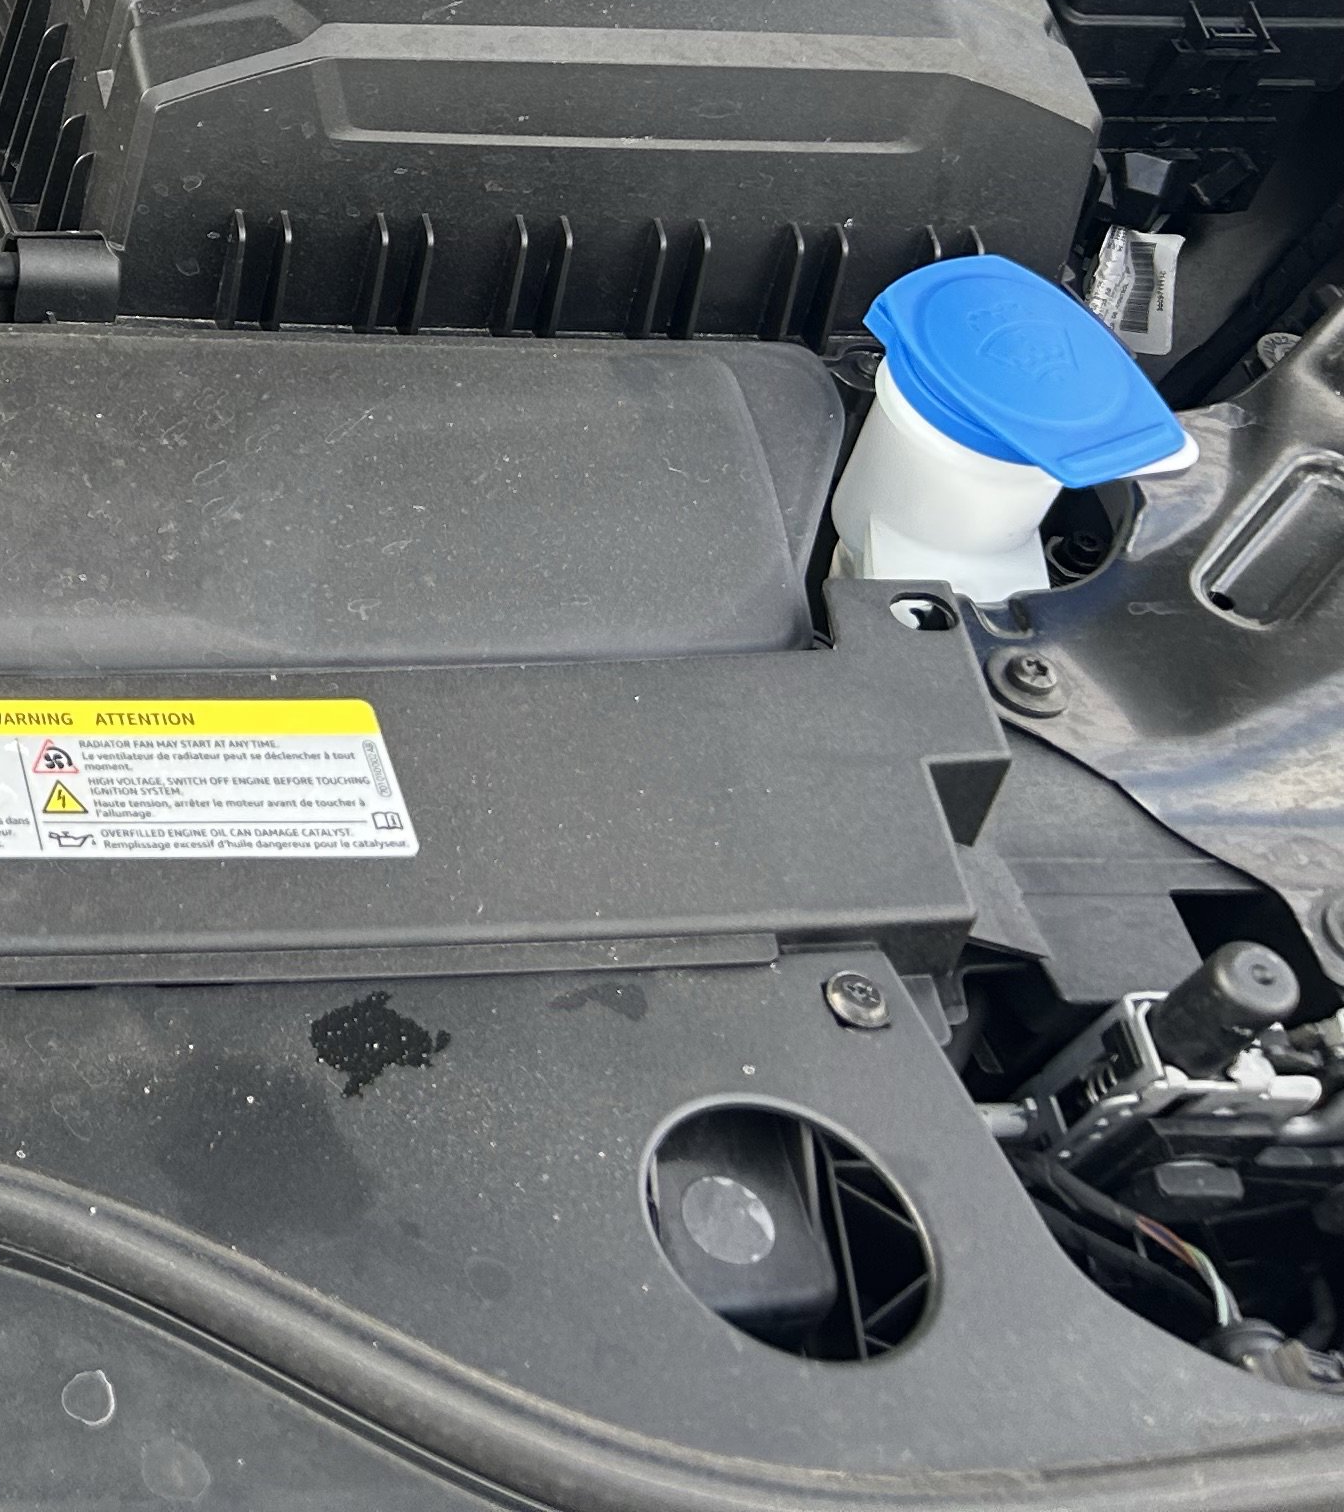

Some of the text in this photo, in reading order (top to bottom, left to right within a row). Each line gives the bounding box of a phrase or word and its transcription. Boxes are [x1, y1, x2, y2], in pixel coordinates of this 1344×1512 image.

[95, 712, 195, 726] ATTENTION
[78, 739, 130, 748] RADIATOR
[133, 739, 154, 748] FAN
[156, 740, 178, 749] MAY
[180, 740, 211, 748] START
[214, 740, 226, 748] AT
[228, 740, 249, 748] ANY
[81, 752, 95, 760] Le
[97, 752, 154, 760] ventilateur
[157, 752, 170, 760] de
[172, 752, 220, 760] radiateur
[223, 752, 248, 762] peut
[264, 752, 321, 760] déclencher
[332, 752, 355, 760] tout
[88, 777, 114, 786] HIGH
[167, 777, 207, 786] SWITCH
[209, 777, 229, 786] OFF
[232, 777, 271, 786] ENGINE
[273, 777, 313, 786] BEFORE
[316, 776, 370, 785] TOUCHING
[90, 787, 138, 796] IGNITION
[93, 799, 126, 808] Haute
[213, 799, 223, 807] le
[299, 799, 313, 807] de
[315, 799, 356, 807] toucher
[5, 816, 30, 825] dans
[100, 829, 165, 837] OVERFILLED
[168, 829, 208, 837] ENGINE
[210, 829, 228, 837] OIL
[230, 828, 252, 837] CAN
[254, 828, 299, 837] DAMAGE
[103, 840, 171, 851] Remplissage
[173, 840, 215, 849] excessif
[256, 839, 311, 850] dangereux
[314, 840, 337, 850] pour
[341, 839, 350, 848] le
